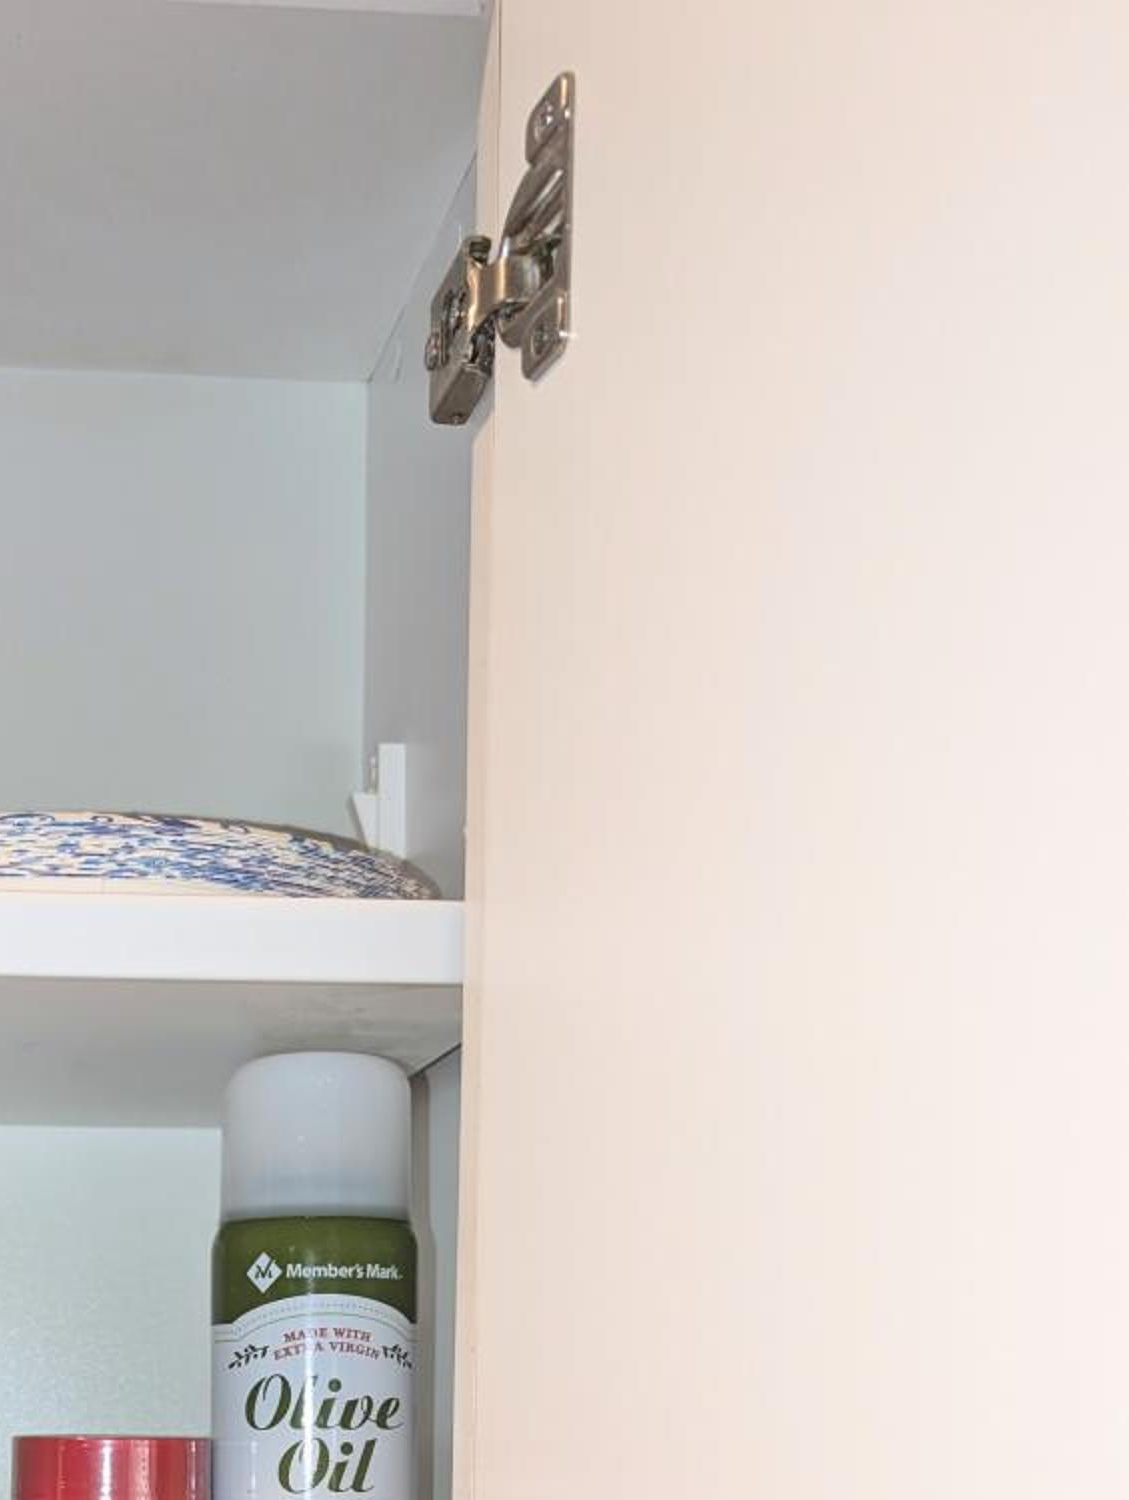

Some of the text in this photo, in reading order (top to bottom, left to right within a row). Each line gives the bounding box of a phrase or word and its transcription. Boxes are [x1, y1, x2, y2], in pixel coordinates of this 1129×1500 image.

[285, 1262, 365, 1279] Member's
[332, 1328, 371, 1342] WITH
[273, 1341, 380, 1361] EXTA VIRGIN
[245, 1373, 405, 1431] Olive
[278, 1437, 378, 1494] Oil
